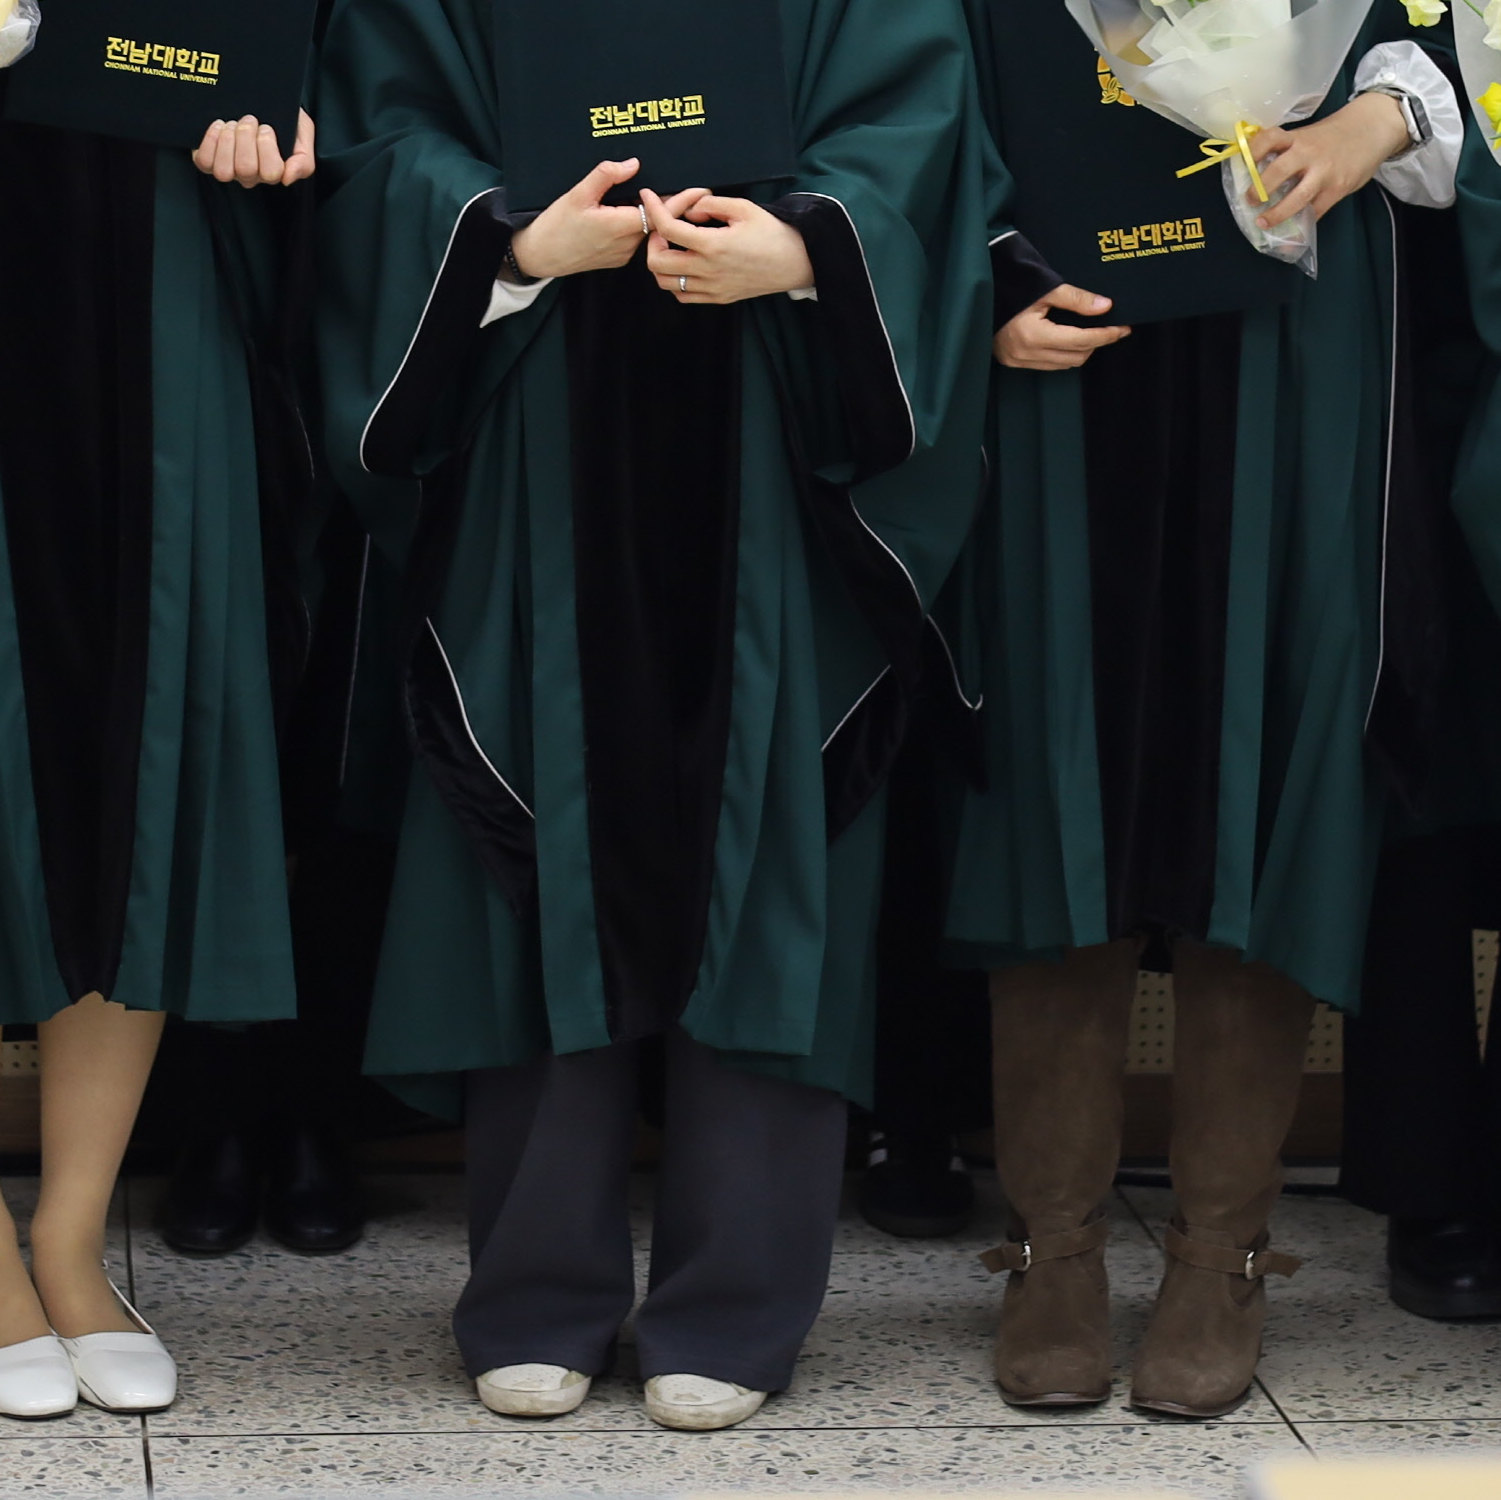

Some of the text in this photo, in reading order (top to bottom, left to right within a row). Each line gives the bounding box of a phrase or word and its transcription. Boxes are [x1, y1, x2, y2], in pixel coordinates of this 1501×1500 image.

[106, 36, 220, 75] 전남대학교
[104, 61, 218, 85] CHONNAM NATIONAL UNIVERSITY
[589, 94, 705, 129] 전남대학교
[592, 117, 705, 138] CHONNAM NATIONAL UNIVERSITY
[1097, 217, 1205, 253] 전남대학교
[1136, 246, 1169, 257] NATIONAL
[1170, 241, 1206, 252] UNIVERSITY
